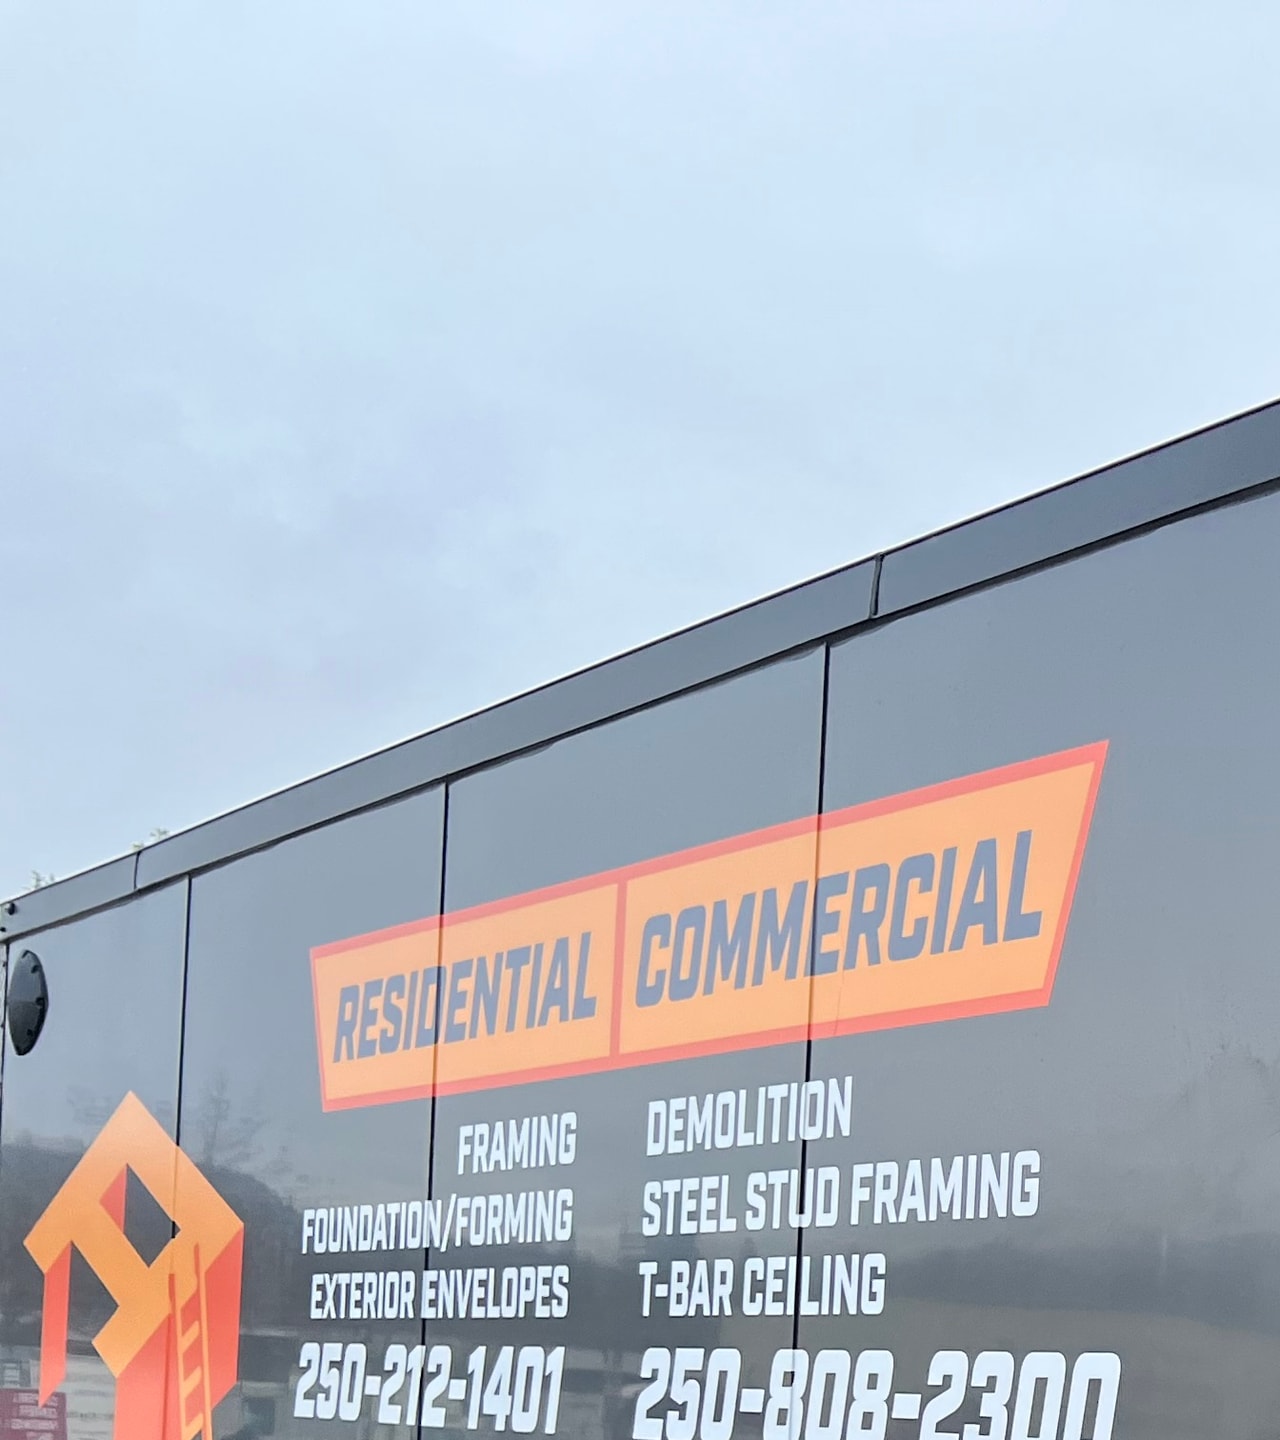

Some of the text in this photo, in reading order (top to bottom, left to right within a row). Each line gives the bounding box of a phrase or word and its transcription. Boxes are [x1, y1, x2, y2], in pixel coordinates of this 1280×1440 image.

[633, 829, 1043, 1009] COMMERCIAL
[332, 930, 599, 1064] RESIDENTIAL
[457, 1111, 577, 1176] FRAMING
[645, 1074, 853, 1158] DEMOLITION
[301, 1187, 574, 1256] FOUNDATION/FORMING
[640, 1150, 1041, 1238] STEEL STUD FRAMING
[309, 1264, 570, 1321] EXTERIOR ENVELOPES
[638, 1252, 886, 1319] T-BAR CEILING
[293, 1341, 565, 1435] 250-212-1401
